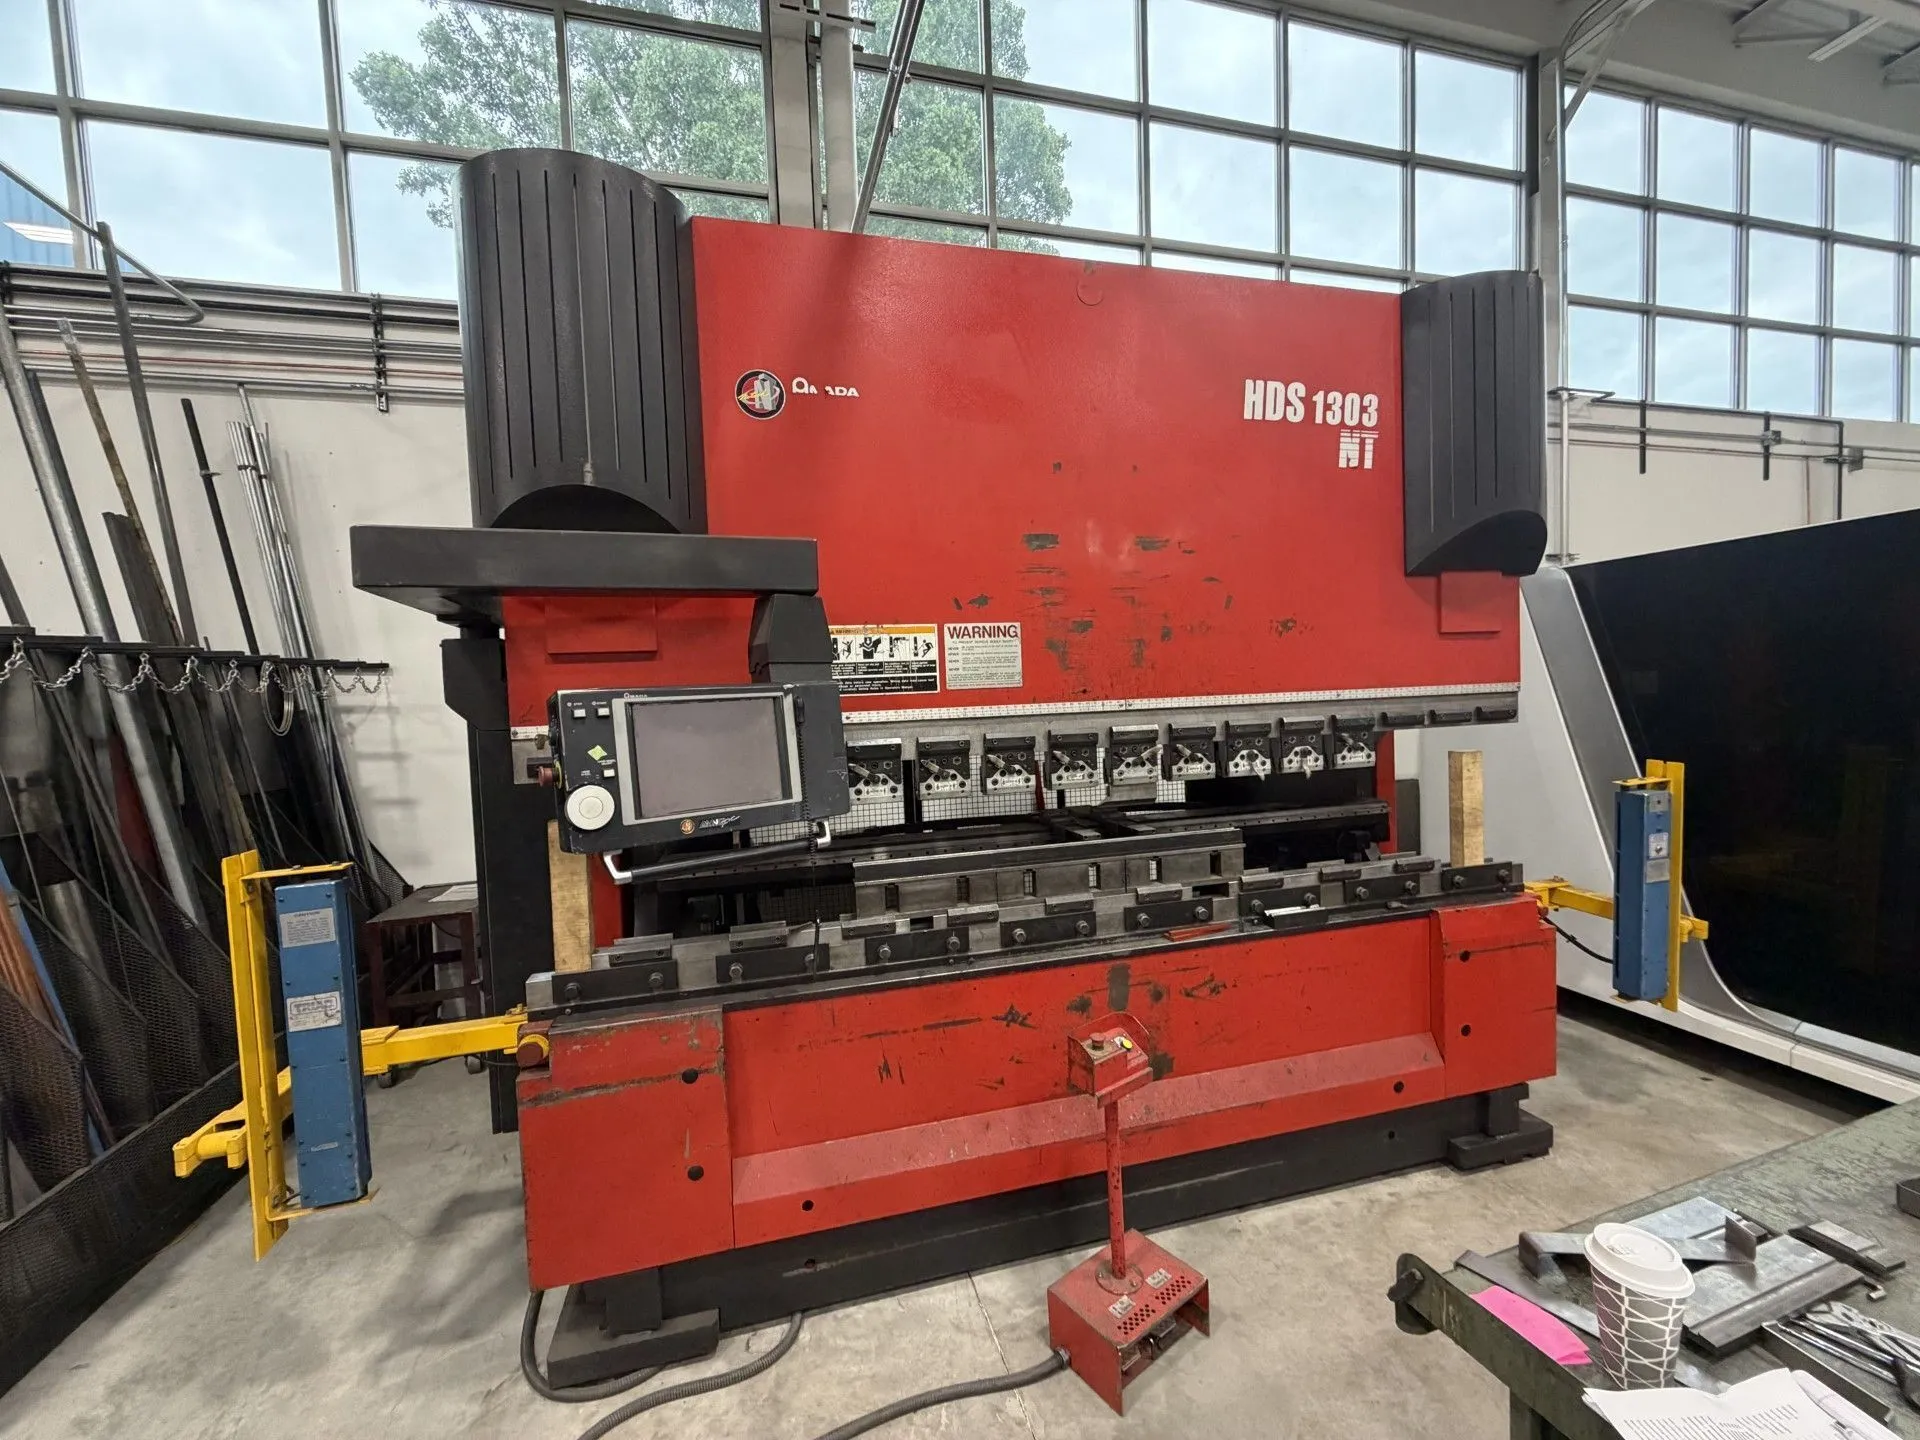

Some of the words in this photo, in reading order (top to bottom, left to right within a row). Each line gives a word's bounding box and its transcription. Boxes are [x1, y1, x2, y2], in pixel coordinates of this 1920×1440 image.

[1243, 378, 1306, 423] HDS
[1311, 389, 1379, 428] 1303
[947, 624, 1019, 640] WARNING
